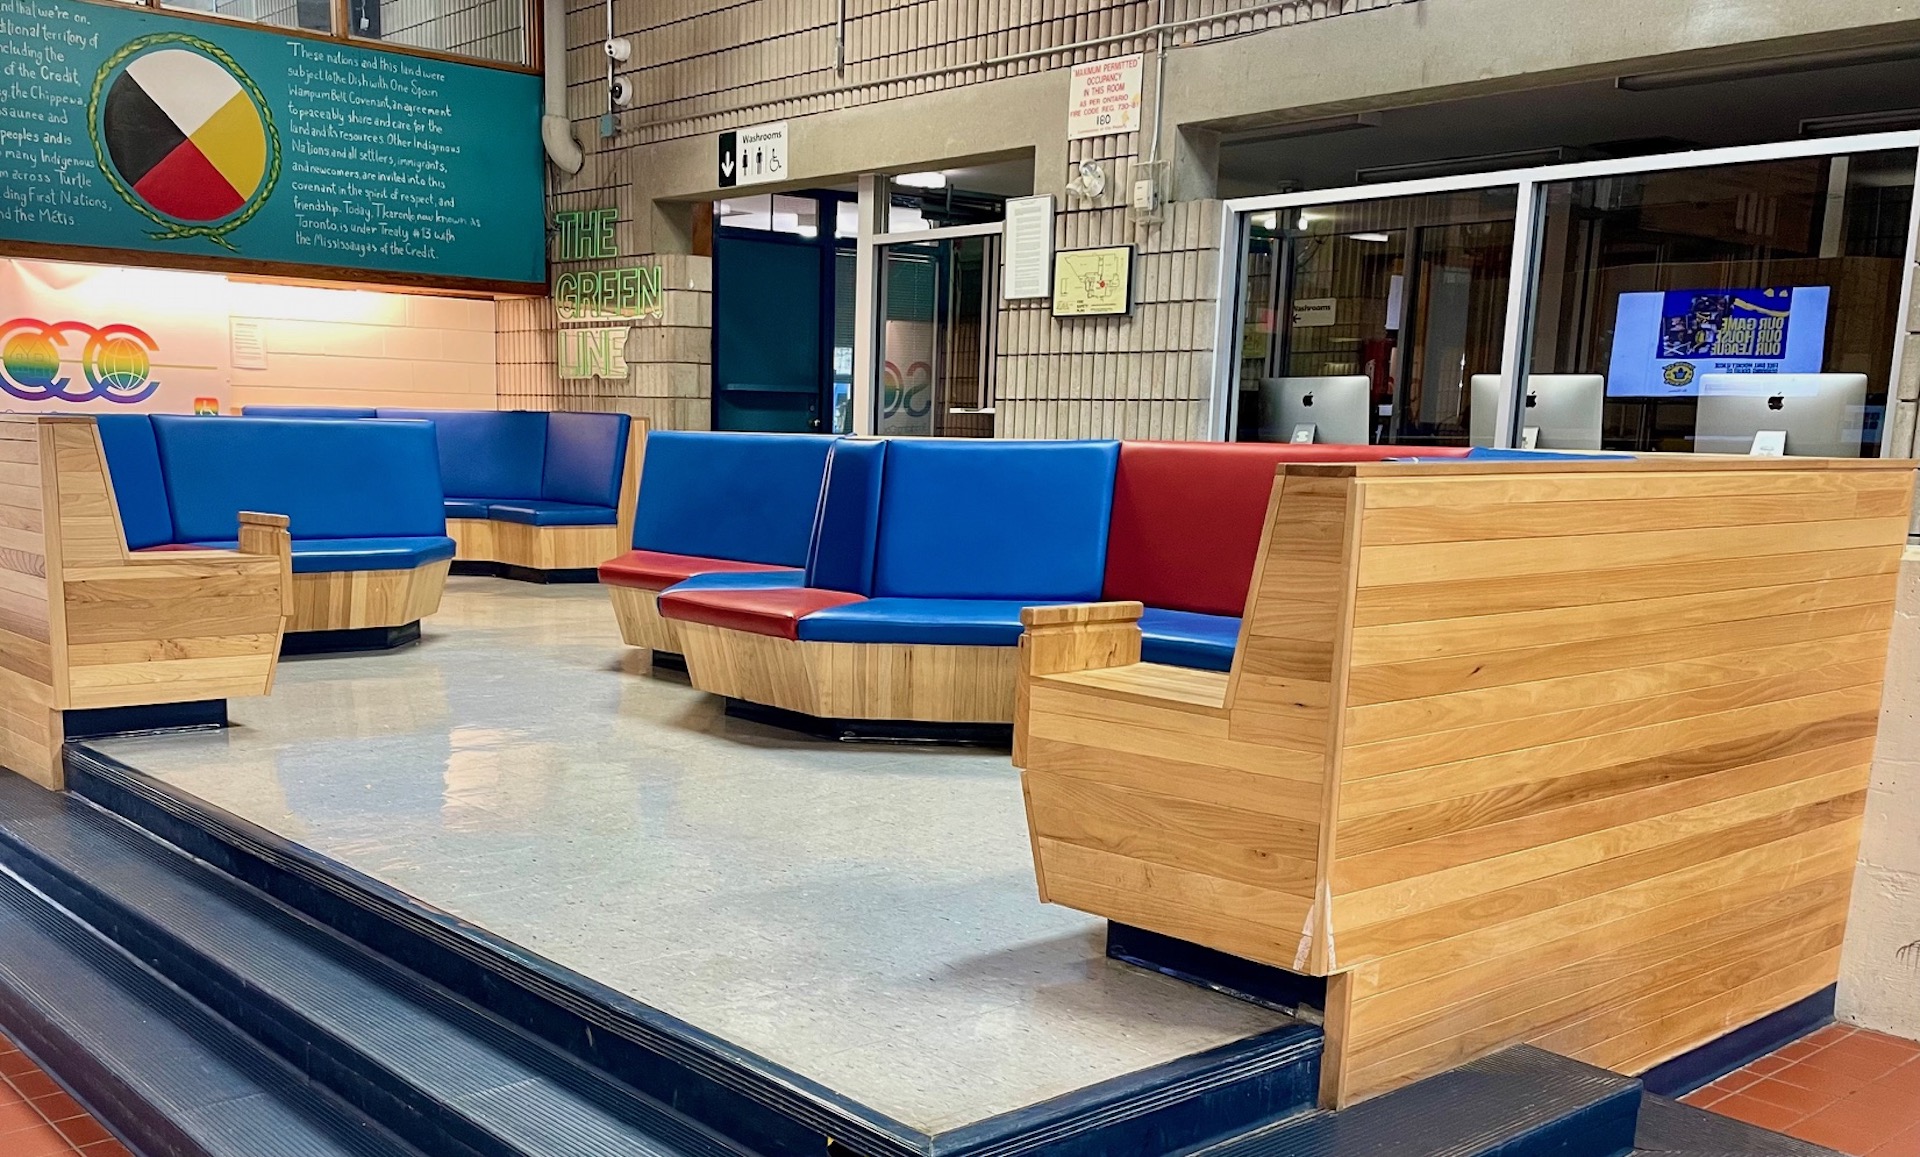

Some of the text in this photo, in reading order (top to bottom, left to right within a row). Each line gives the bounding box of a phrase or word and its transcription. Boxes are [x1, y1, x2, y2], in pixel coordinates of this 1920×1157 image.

[38, 5, 70, 19] we're
[42, 24, 87, 50] territory
[89, 33, 99, 49] of
[45, 45, 65, 63] the
[286, 41, 445, 82] These nations and this land were
[4, 61, 16, 76] of
[19, 62, 36, 79] the
[287, 64, 324, 85] subject
[325, 70, 333, 82] to
[332, 71, 347, 85] the
[348, 71, 369, 87] Dish
[370, 74, 389, 90] with
[390, 78, 408, 93] One
[1087, 73, 1122, 86] OCCUPANCY
[11, 82, 28, 100] the
[287, 83, 452, 117] Wampum Belt Covenant, an agreement
[1084, 83, 1125, 97] IN THIS ROOM
[1102, 94, 1128, 104] ONTARIO
[0, 107, 68, 124] saunee and
[287, 100, 443, 134] to peaceably share and care for the
[1083, 107, 1099, 115] CODE
[0, 127, 72, 147] peoples and is
[289, 118, 310, 136] land
[310, 123, 327, 138] and
[327, 123, 339, 139] its
[386, 132, 412, 148] Other
[413, 133, 461, 156] Indigenous
[742, 131, 782, 144] Washrooms
[5, 148, 95, 170] many Indigenous
[331, 147, 347, 159] and
[347, 146, 358, 160] all
[359, 148, 397, 167] settlers,
[397, 158, 448, 174] immigrants,
[12, 170, 51, 183] across
[54, 169, 92, 189] Turtle
[291, 160, 310, 173] and
[362, 170, 377, 181] are
[377, 170, 406, 184] invited
[406, 173, 426, 187] into
[428, 173, 446, 190] this
[28, 186, 57, 206] First
[61, 190, 112, 212] Nations,
[291, 180, 337, 195] covenant
[338, 185, 347, 196] in
[347, 181, 363, 197] the
[364, 186, 388, 202] spirit
[390, 187, 399, 201] of
[438, 196, 456, 209] and
[14, 206, 35, 223] the
[416, 212, 434, 223] now
[435, 209, 468, 225] known
[469, 216, 481, 229] as
[339, 222, 349, 234] is
[350, 221, 378, 236] under
[378, 221, 409, 243] Treaty
[434, 228, 456, 244] with
[555, 208, 619, 259] THE
[295, 229, 439, 260] the Mississaugas of the Credit.
[555, 265, 664, 320] GREEN
[558, 328, 629, 378] LINE
